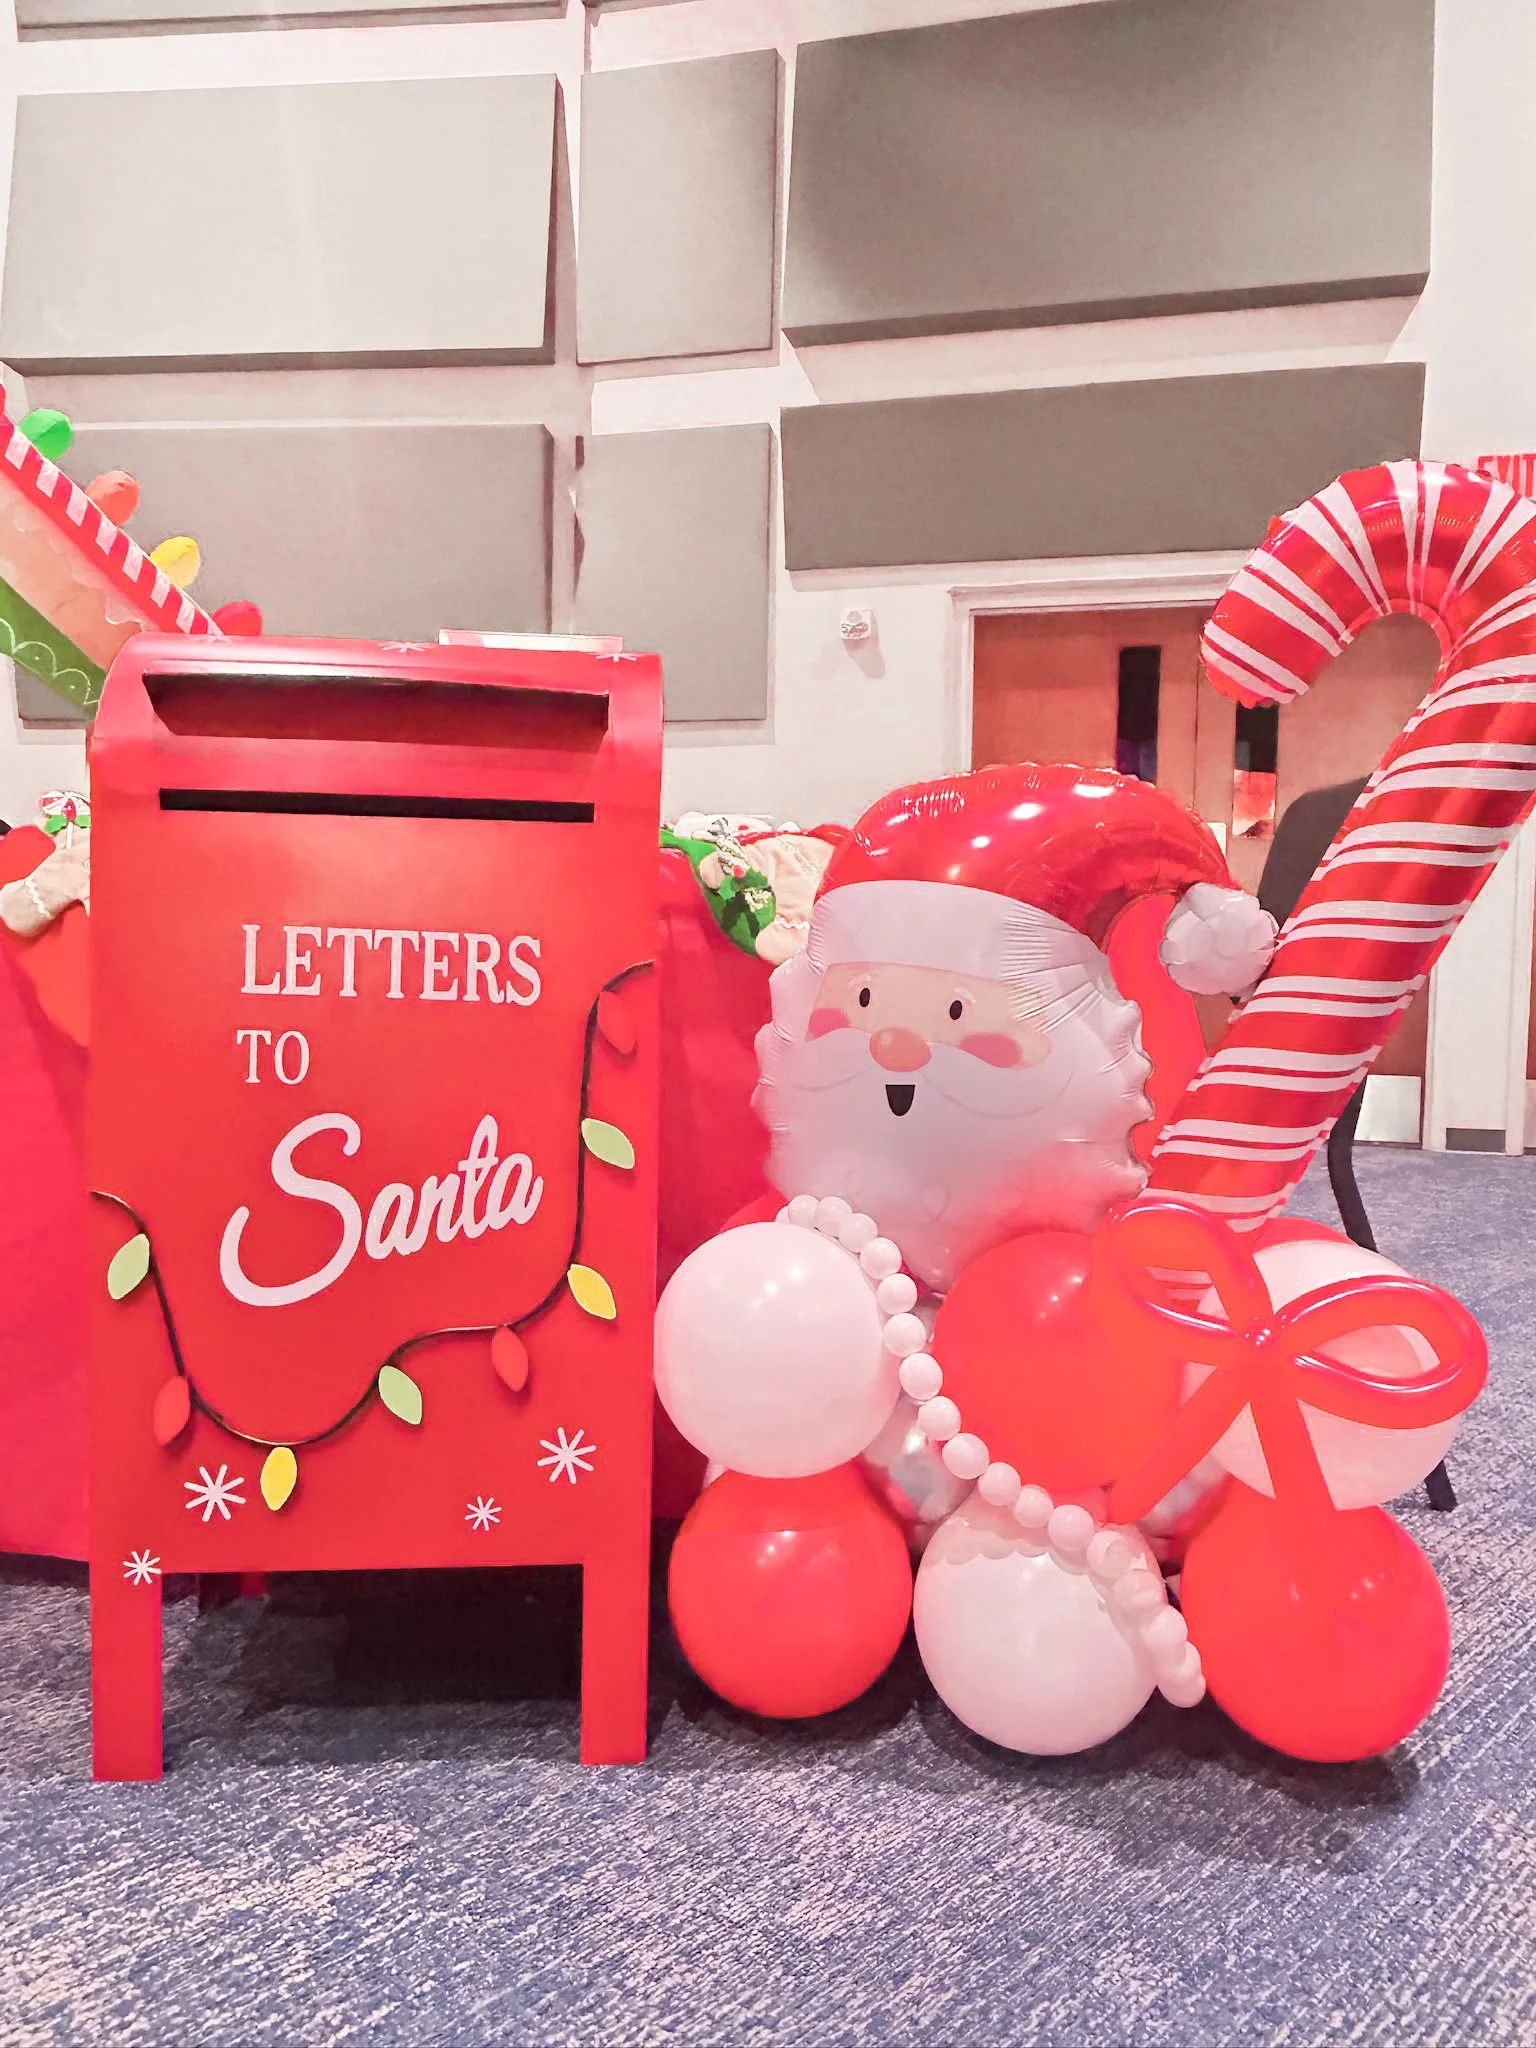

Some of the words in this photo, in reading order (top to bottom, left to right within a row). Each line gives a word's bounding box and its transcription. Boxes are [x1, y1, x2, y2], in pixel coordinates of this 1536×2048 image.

[240, 924, 542, 1006] LETTERS
[236, 1029, 310, 1085] TO
[219, 1112, 544, 1307] Santa
